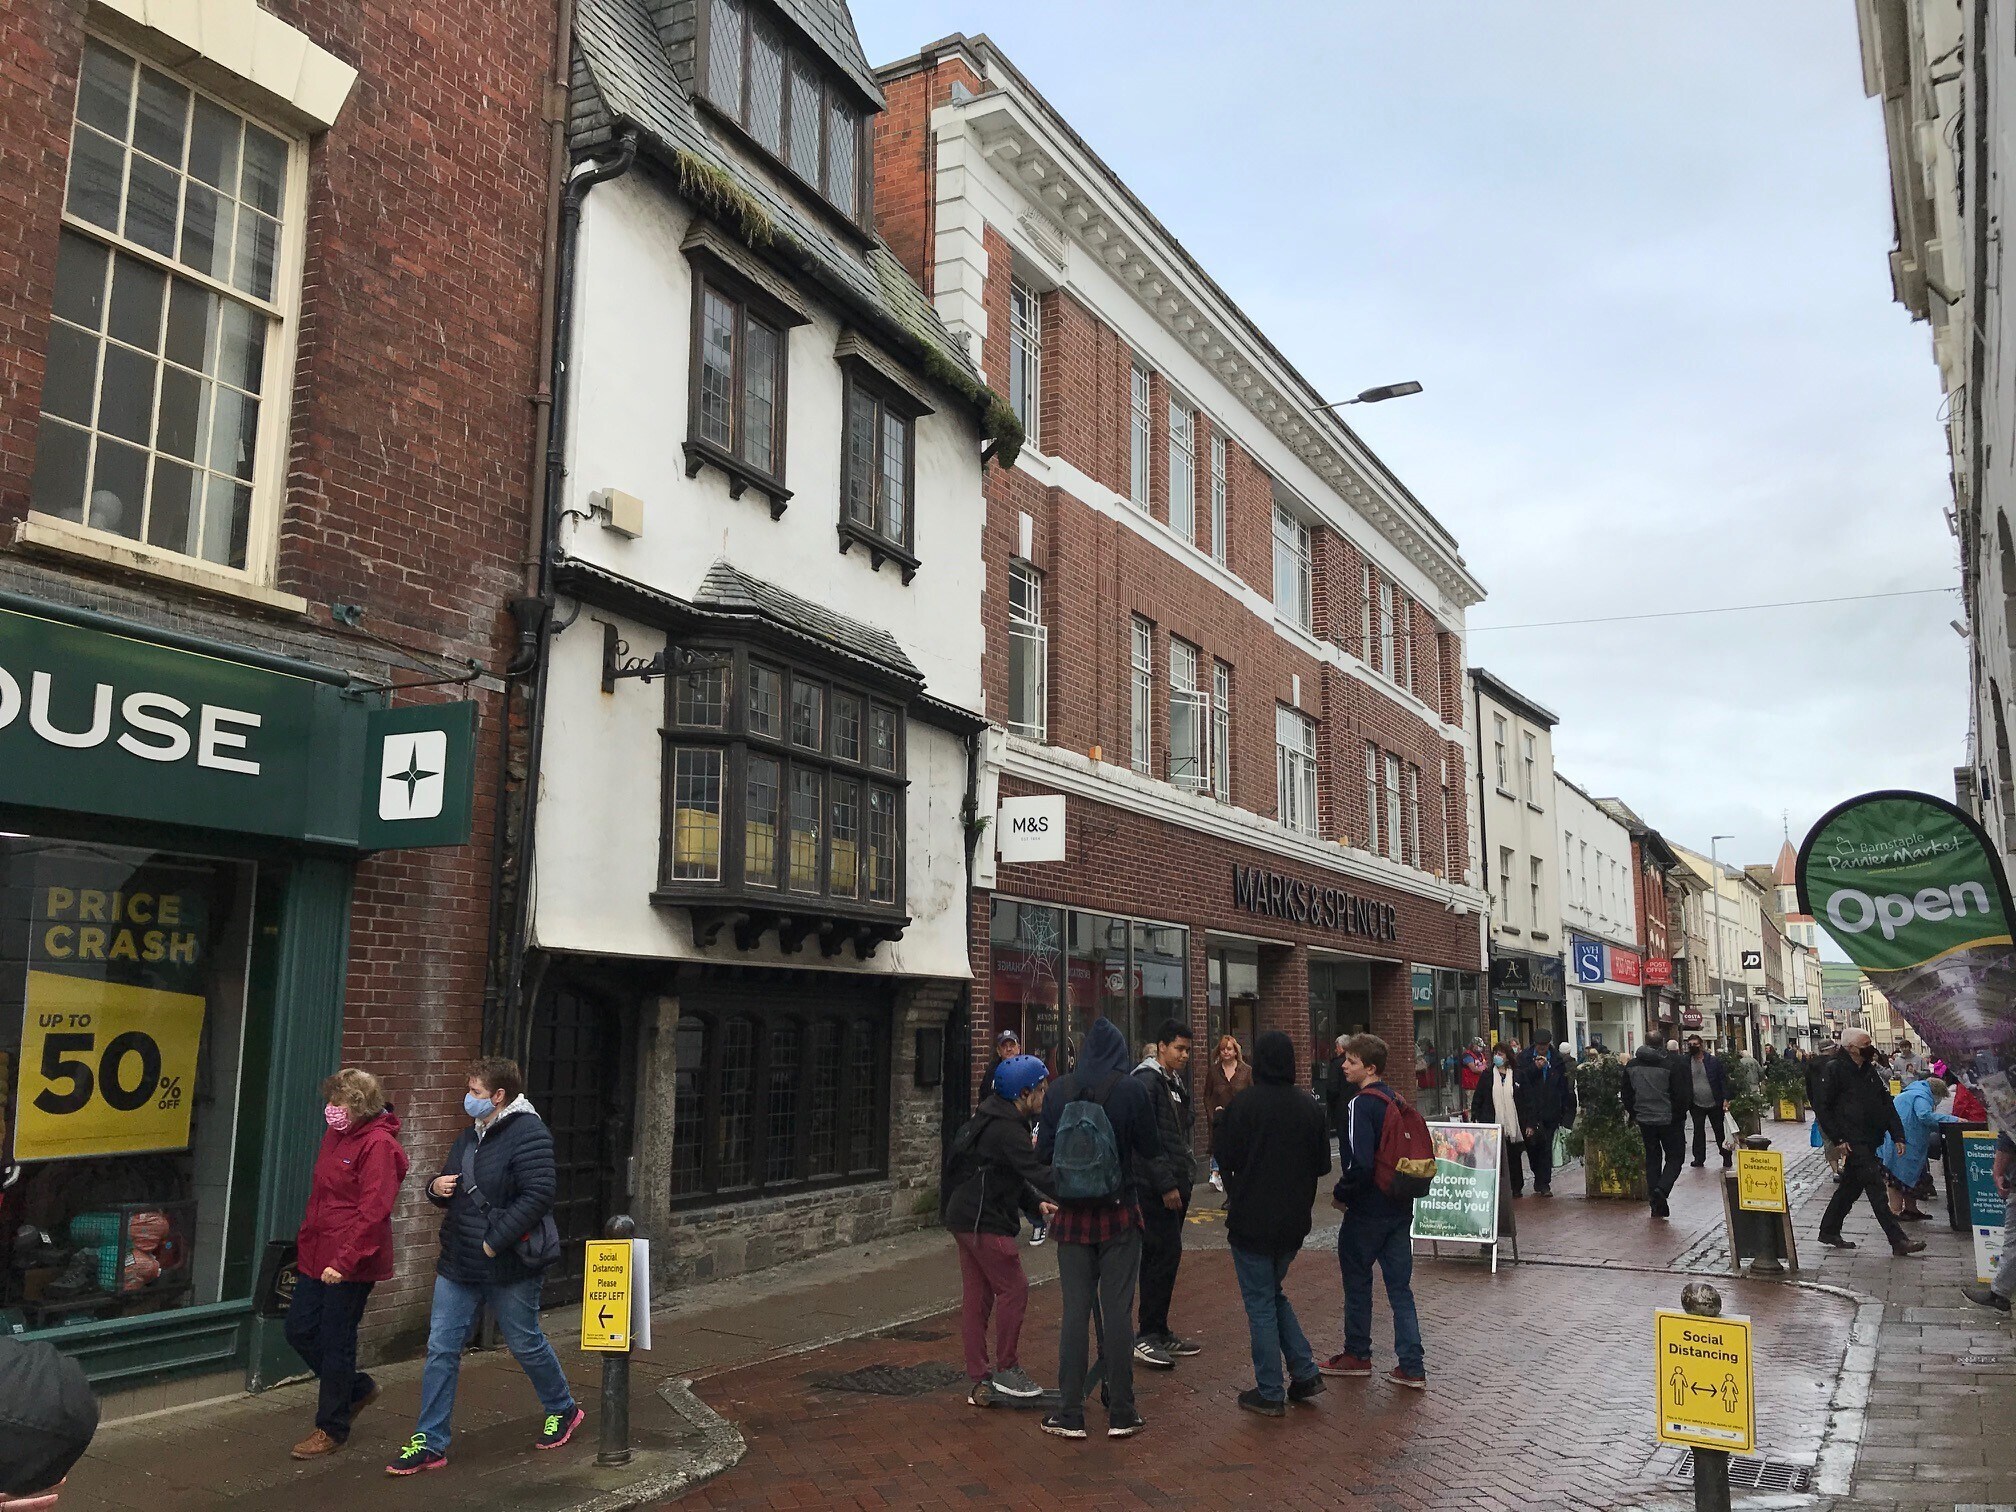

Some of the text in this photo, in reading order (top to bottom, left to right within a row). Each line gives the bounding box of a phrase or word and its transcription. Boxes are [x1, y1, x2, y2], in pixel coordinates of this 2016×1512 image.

[0, 666, 262, 776] USE
[1013, 816, 1049, 833] M&S
[1860, 833, 1925, 853] Barnstaple
[1827, 835, 1964, 872] Pannier Market
[46, 886, 182, 926] PRICE
[1826, 881, 1990, 941] Open
[44, 924, 197, 964] CRASH
[1581, 946, 1599, 954] WH
[1582, 954, 1601, 982] S
[1743, 954, 1760, 966] JD
[39, 1013, 92, 1029] UP TO
[158, 1099, 181, 1111] OFF
[1743, 1163, 1778, 1172] Distancing
[1750, 1156, 1770, 1164] Social
[1430, 1173, 1477, 1186] elcome
[1429, 1186, 1489, 1199] ack, we've
[1420, 1198, 1490, 1214] missed you!
[599, 1252, 617, 1262] Social
[593, 1264, 623, 1274] Distancing
[597, 1278, 617, 1288] Please
[589, 1291, 625, 1301] KEEP LEFT
[1683, 1330, 1724, 1346] Social
[1669, 1343, 1739, 1364] Distancing
